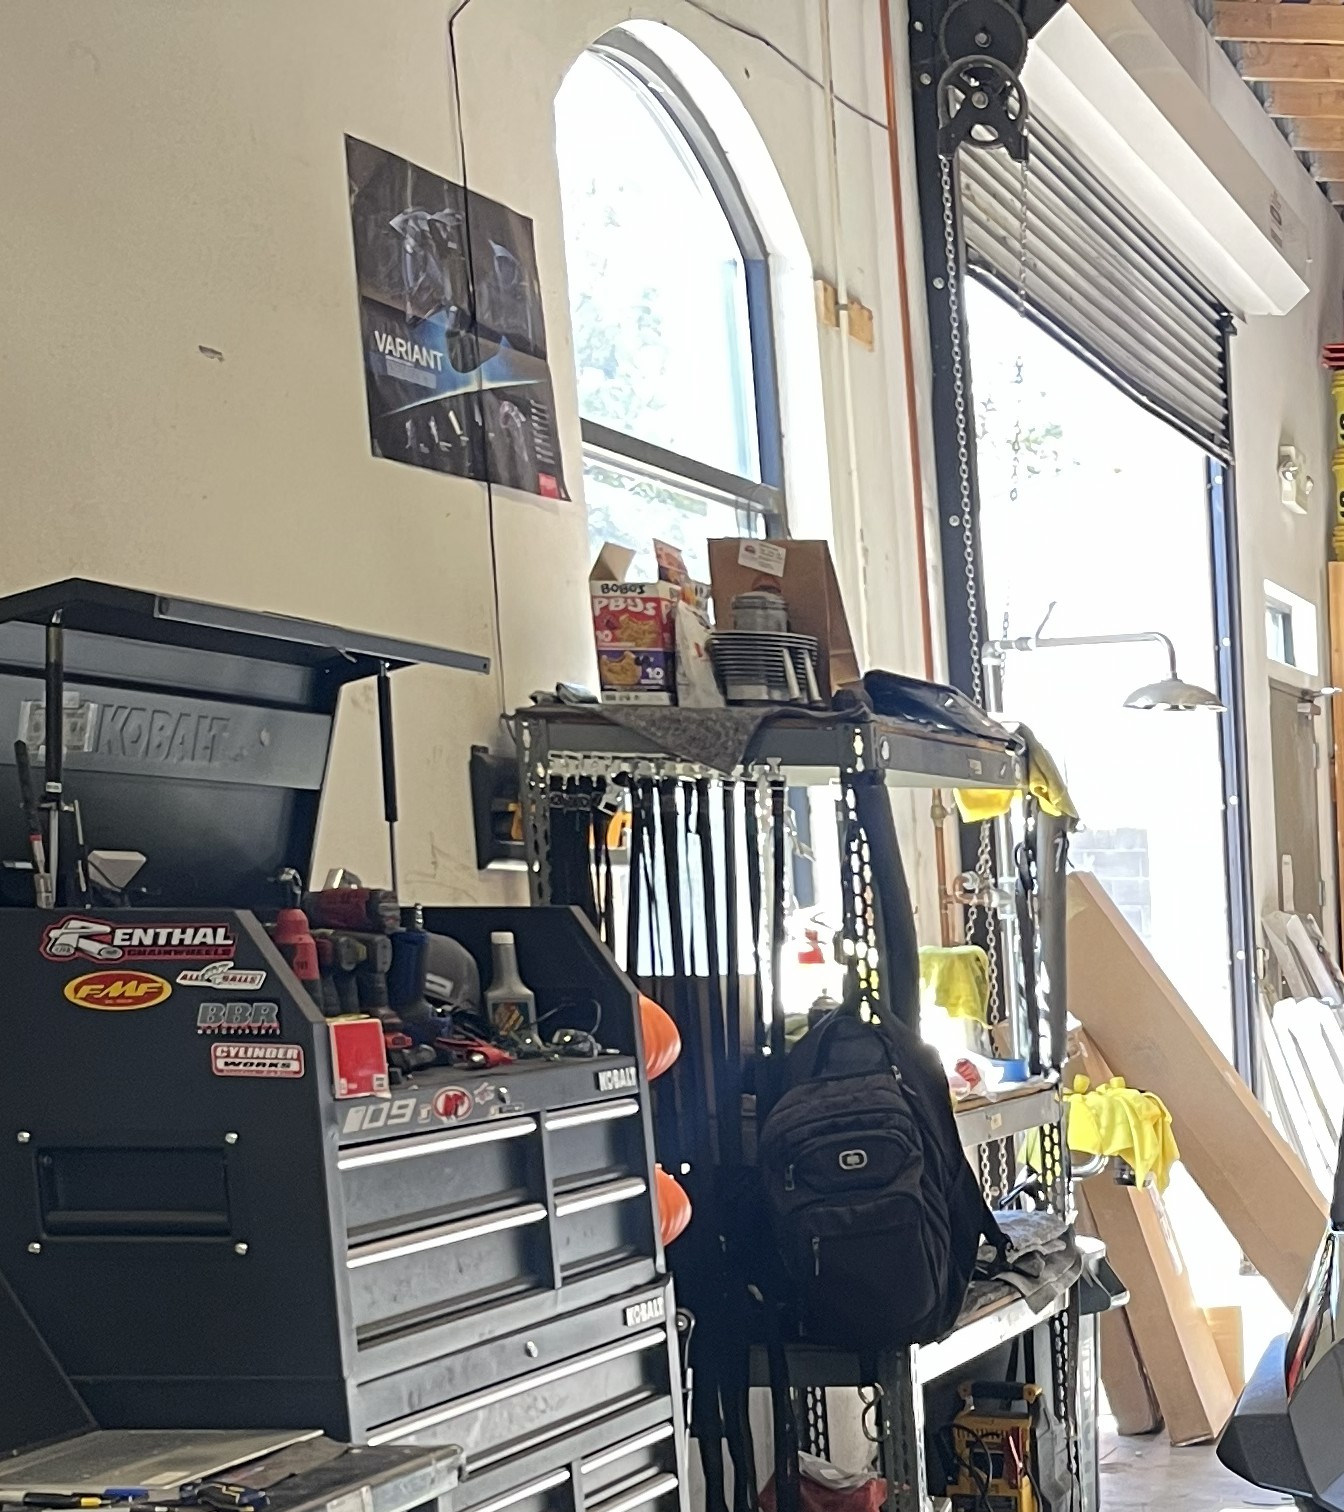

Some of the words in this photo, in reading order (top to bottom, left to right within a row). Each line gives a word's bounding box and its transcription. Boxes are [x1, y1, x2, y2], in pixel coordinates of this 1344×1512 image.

[374, 330, 444, 372] VARIANT
[646, 667, 664, 679] 10
[96, 703, 231, 764] KOBALT
[74, 980, 163, 999] FMF
[197, 1003, 279, 1026] BBR
[215, 1046, 299, 1060] CYLINDER
[223, 1060, 291, 1069] WORKS
